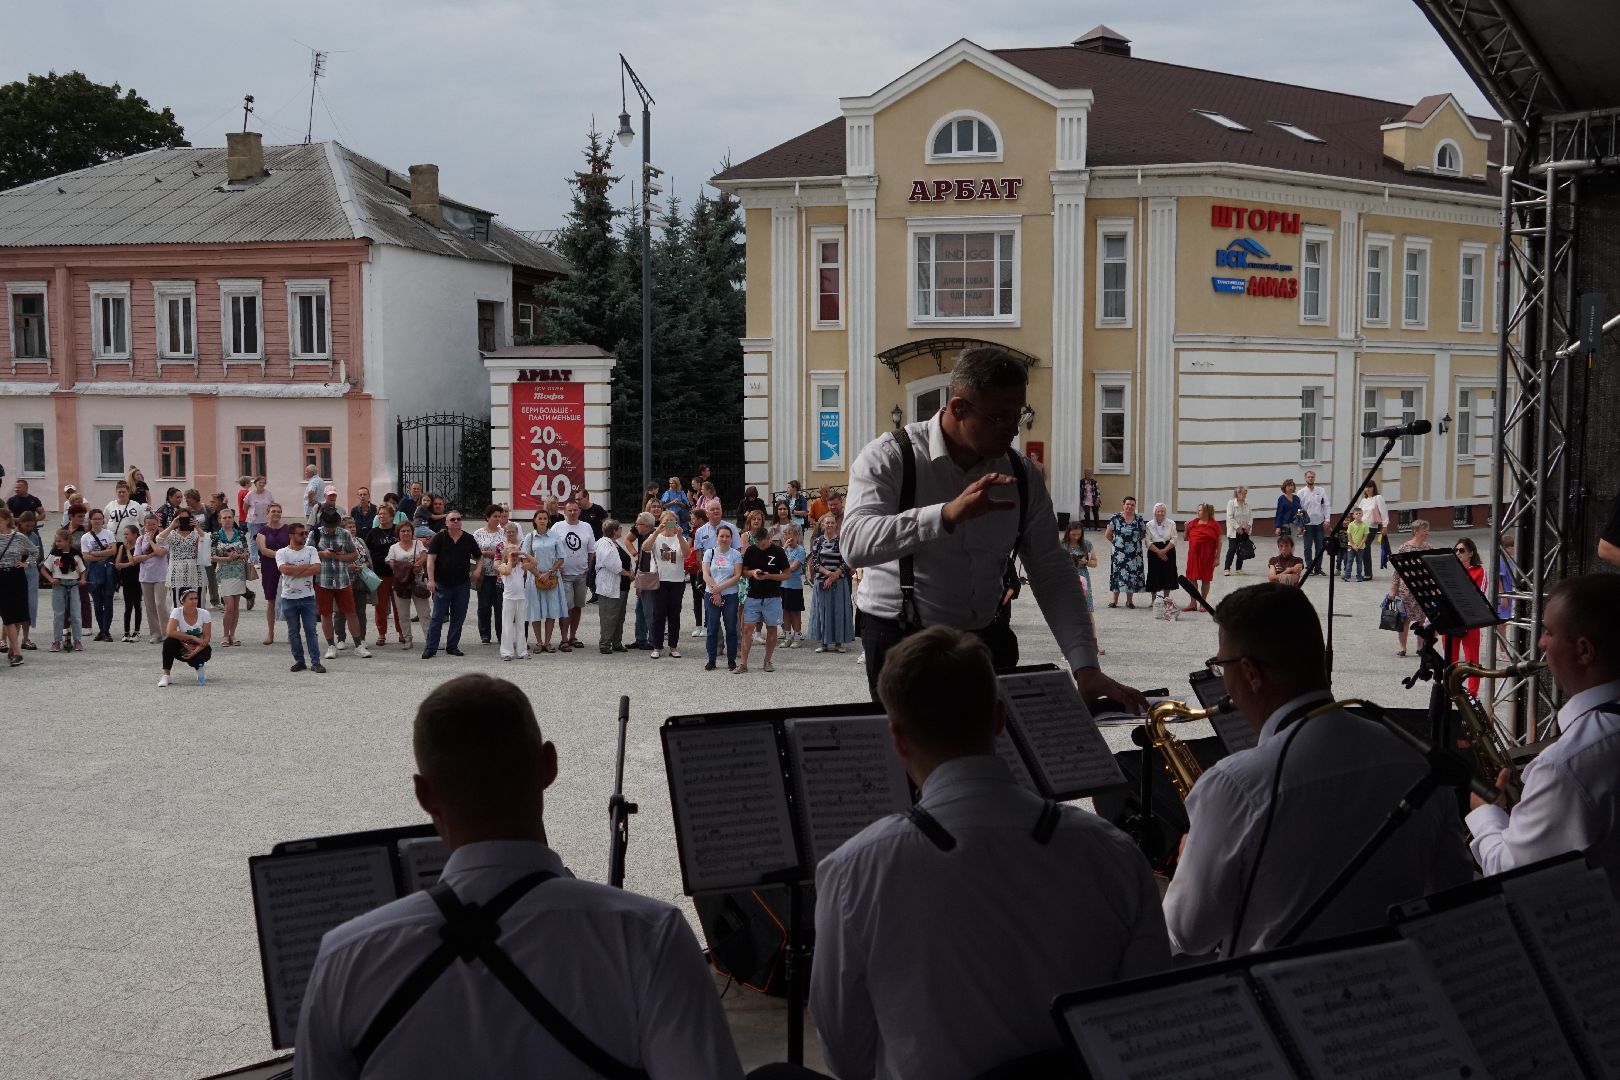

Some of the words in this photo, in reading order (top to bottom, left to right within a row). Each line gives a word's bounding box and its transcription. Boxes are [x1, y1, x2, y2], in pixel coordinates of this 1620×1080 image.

[908, 177, 1023, 203] АРБАТ
[1211, 205, 1300, 235] ШТОРЫ
[945, 248, 989, 260] INDGO
[1216, 249, 1249, 269] ВСК
[1247, 275, 1298, 299] АЛМАЗ
[517, 369, 572, 382] АРБАТ
[521, 406, 539, 414] БЕРИ
[539, 406, 569, 414] БОЛЬШЕ
[767, 555, 776, 566] Z
